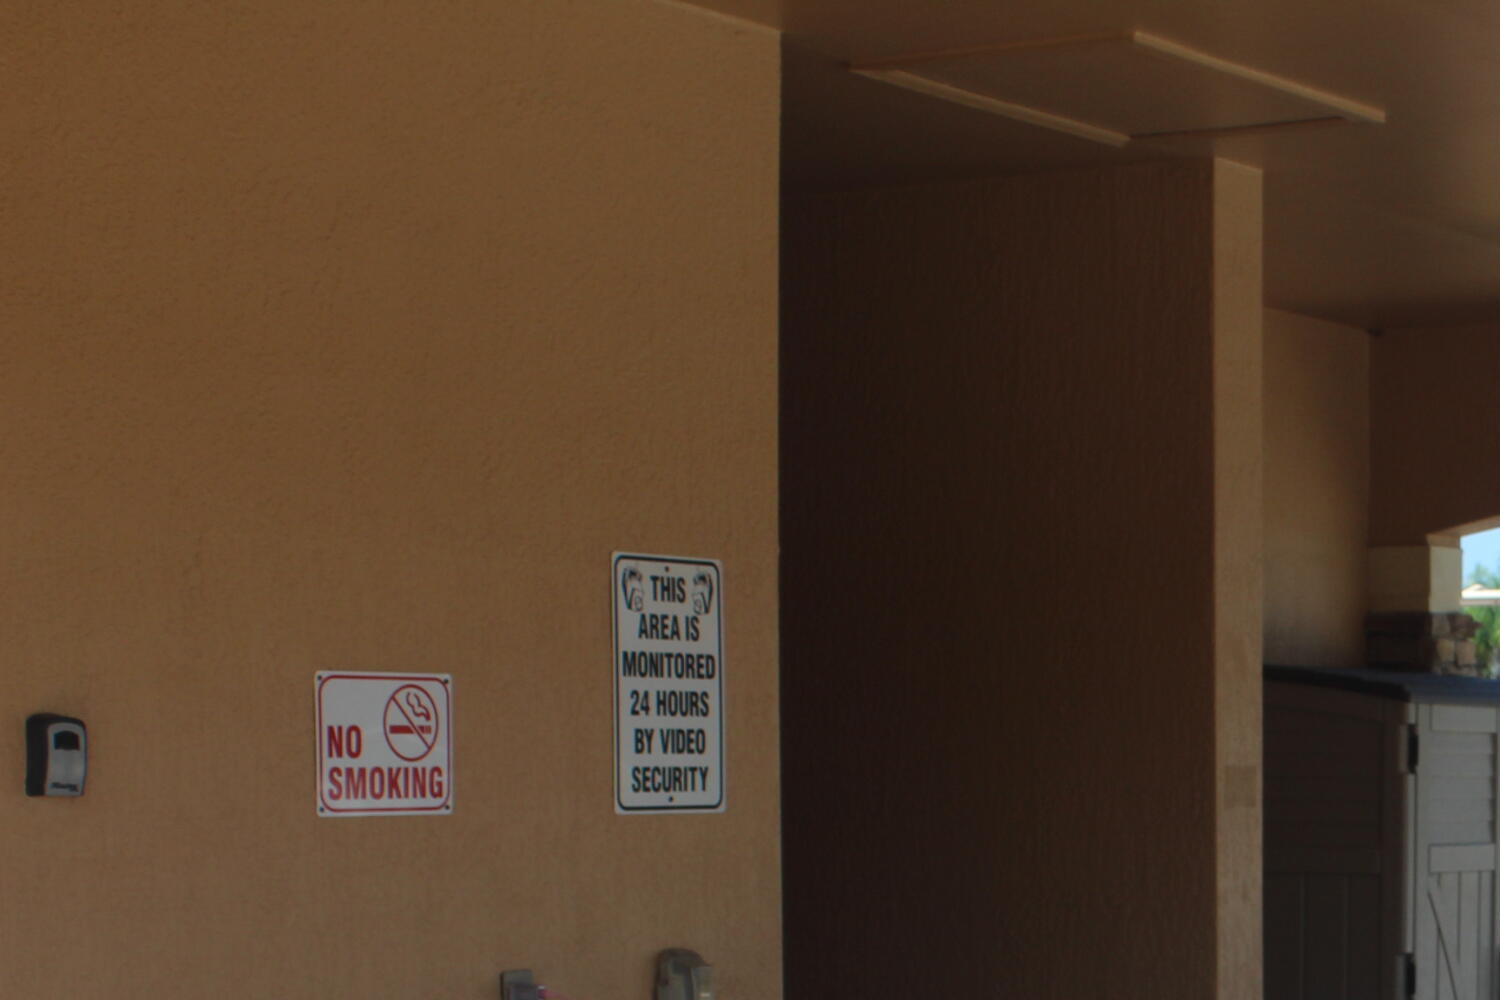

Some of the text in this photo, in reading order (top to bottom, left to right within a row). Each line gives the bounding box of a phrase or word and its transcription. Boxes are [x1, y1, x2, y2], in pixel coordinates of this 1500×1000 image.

[650, 575, 686, 603] THIS
[638, 613, 700, 642] AREA IS
[622, 651, 715, 679] MONITORED
[630, 690, 709, 717] 24 HOURS
[327, 725, 362, 759] NO
[634, 728, 706, 754] BY VIDEO
[328, 766, 444, 800] SMOKING
[631, 767, 709, 792] SECURITY
